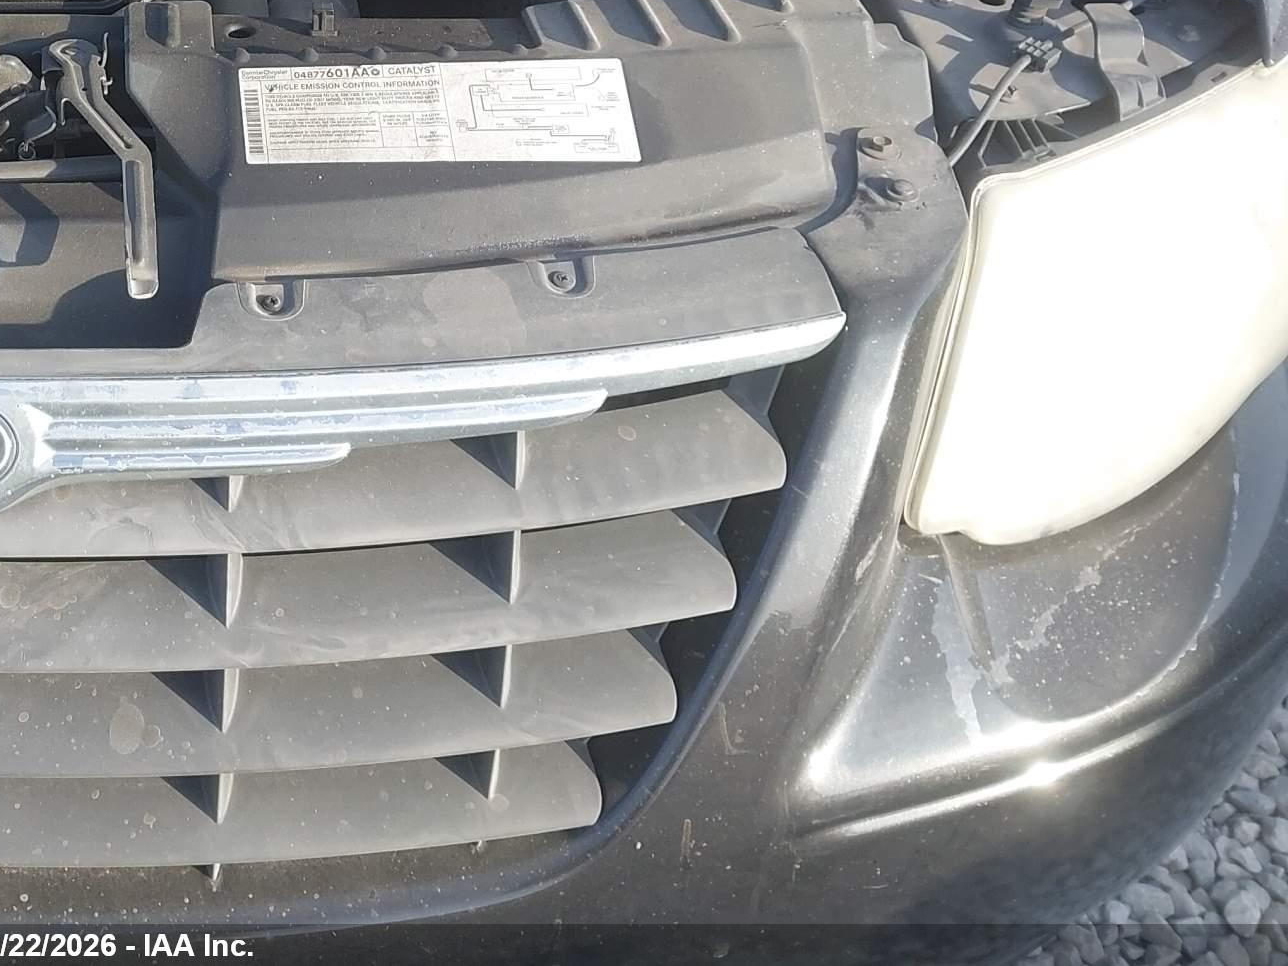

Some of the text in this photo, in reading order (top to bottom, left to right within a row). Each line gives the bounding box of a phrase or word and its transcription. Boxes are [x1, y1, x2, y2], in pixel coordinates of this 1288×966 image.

[388, 66, 436, 76] CATALYST
[300, 82, 340, 90] EMISSION
[342, 81, 381, 89] CONTROL
[383, 80, 440, 88] INFORMATION
